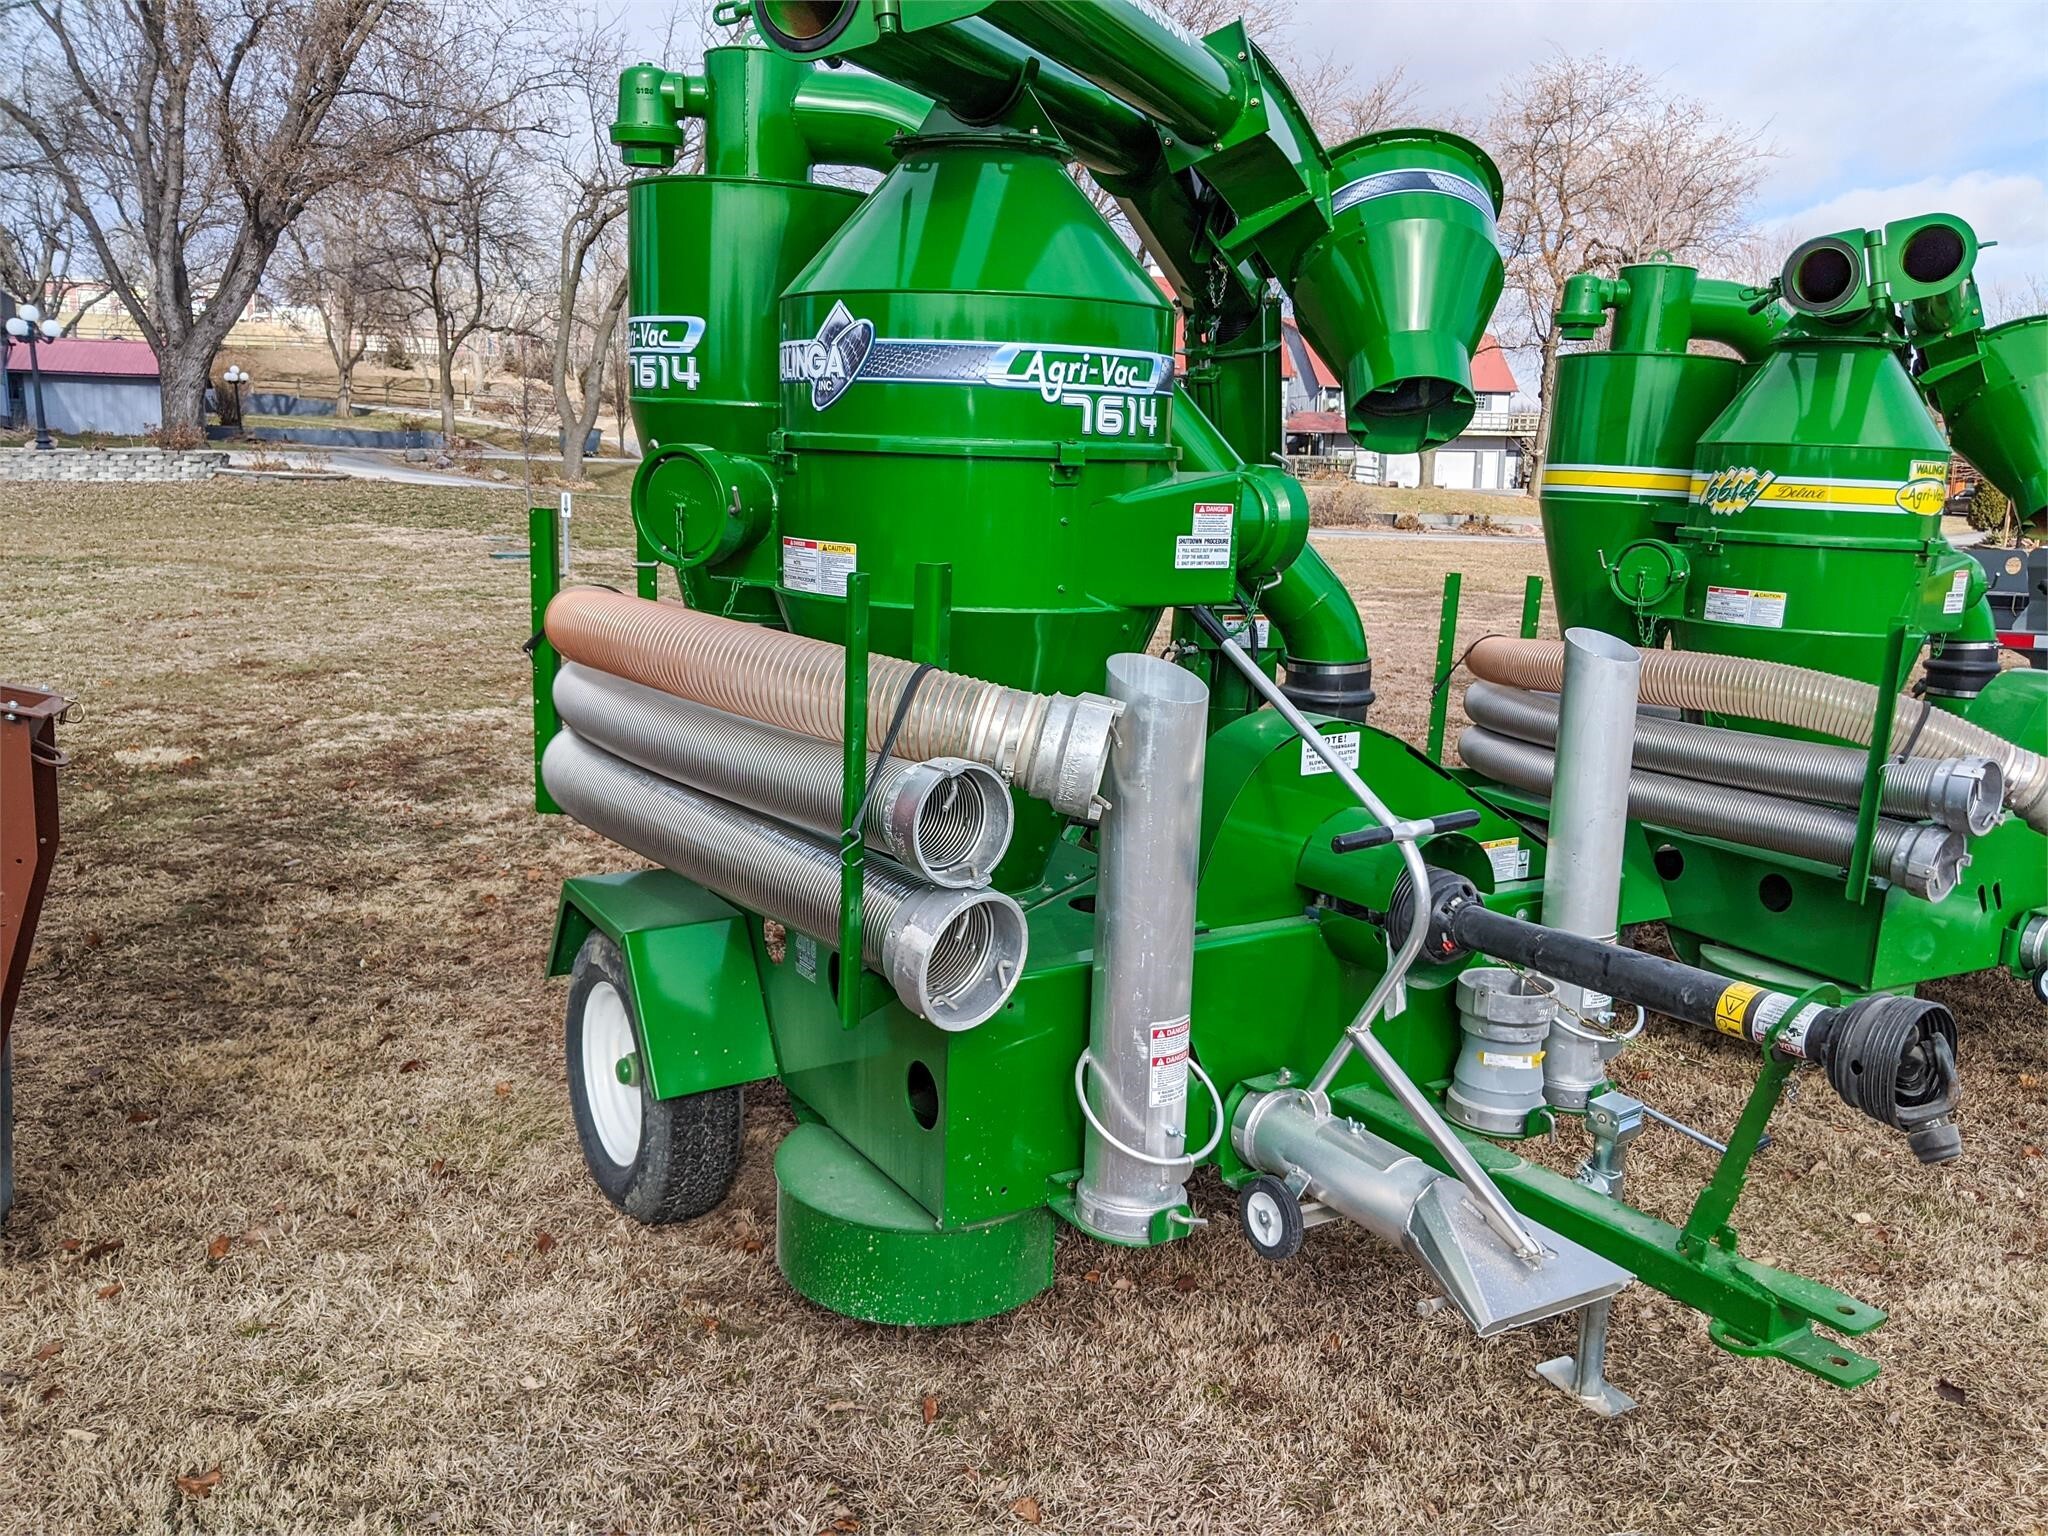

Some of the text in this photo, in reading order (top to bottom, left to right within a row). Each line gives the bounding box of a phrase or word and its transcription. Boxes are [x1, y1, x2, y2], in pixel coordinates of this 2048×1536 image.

[630, 322, 669, 347] ri-Vac
[780, 342, 847, 378] ALINGA
[818, 380, 834, 391] INC.
[1020, 350, 1140, 402] Agri-Vac
[1061, 392, 1157, 436] 7614
[1707, 478, 1825, 503] 6614 Deluxe
[1324, 735, 1347, 744] OTE!
[1166, 1023, 1188, 1036] DANGER
[1165, 1051, 1187, 1064] DANGER
